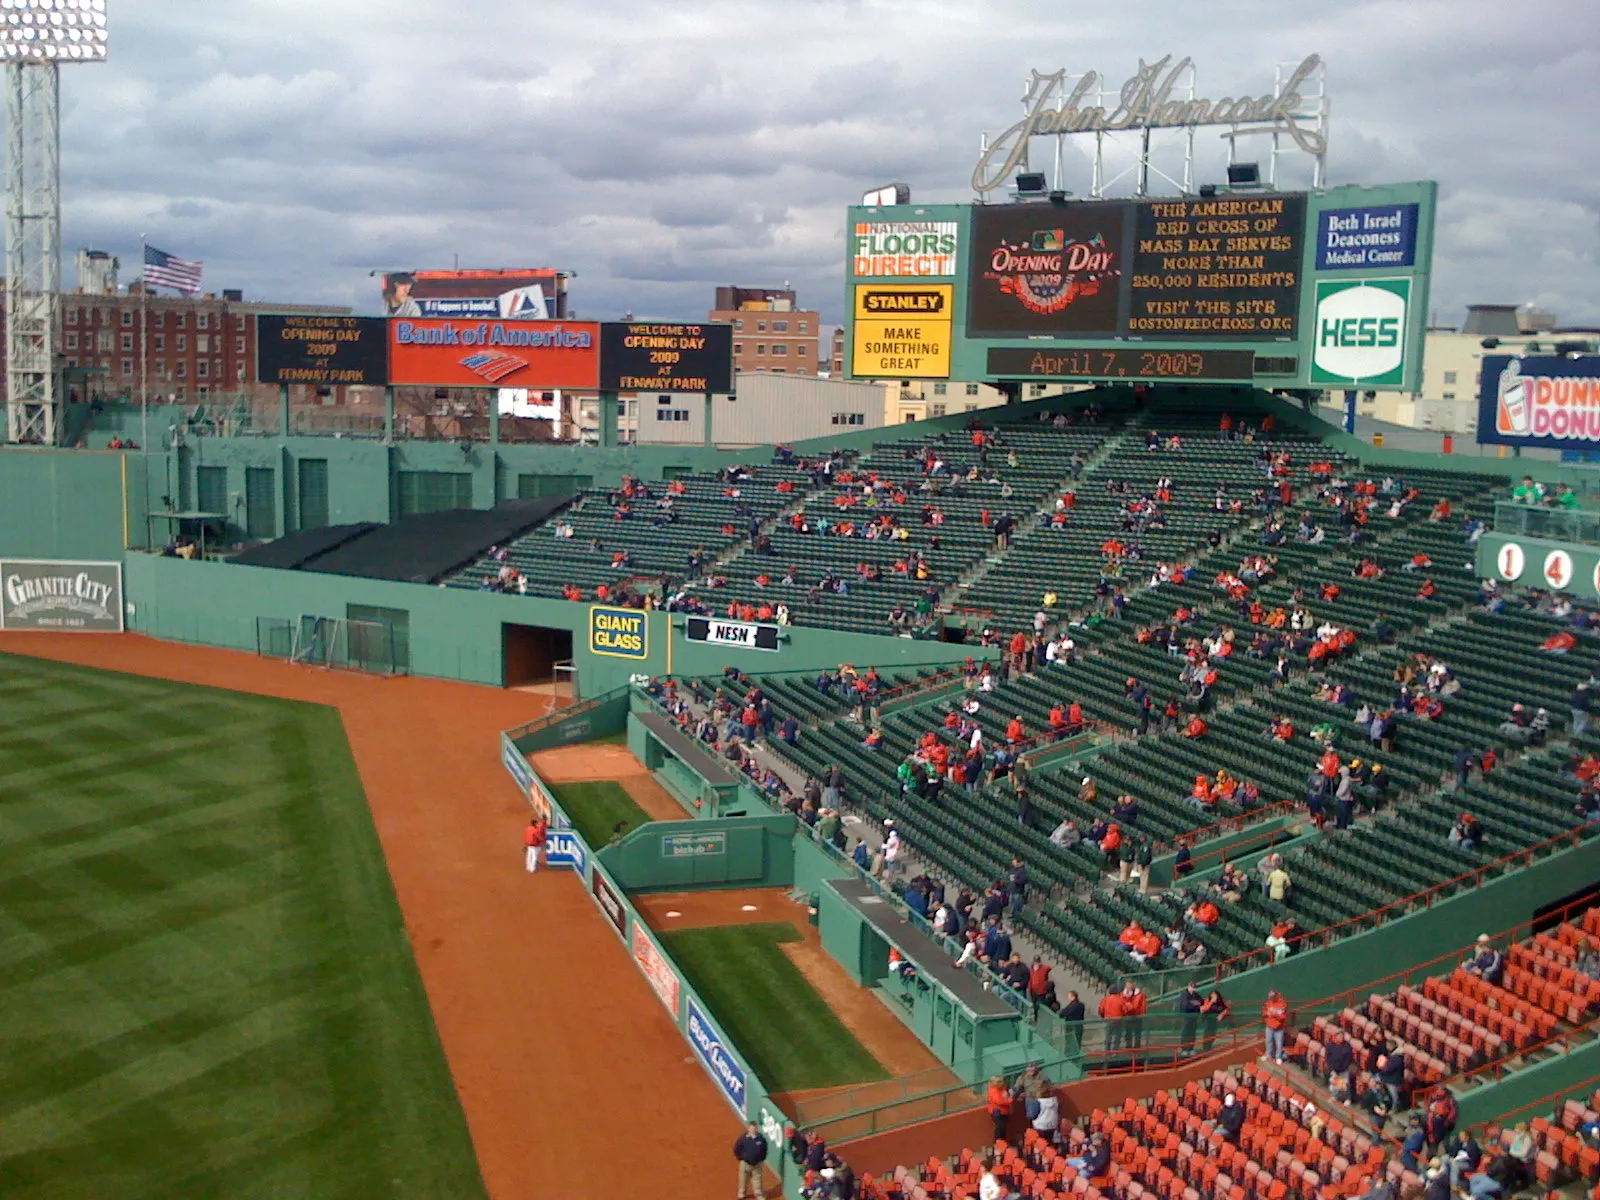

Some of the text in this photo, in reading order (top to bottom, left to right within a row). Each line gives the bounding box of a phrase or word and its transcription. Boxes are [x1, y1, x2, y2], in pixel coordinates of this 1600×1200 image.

[972, 54, 1327, 191] John Hancock
[1152, 200, 1283, 217] THE AMERICAN
[871, 223, 939, 234] NATIONAL
[1156, 219, 1278, 235] RED CROSS OF
[1328, 210, 1401, 231] Beth Israel
[855, 234, 955, 255] FLOORS
[1140, 236, 1292, 253] MASS BAY SERVES
[1327, 232, 1400, 248] Deaconess
[991, 244, 1113, 272] OPENING DAY
[1163, 255, 1265, 270] MORE THAN
[1326, 249, 1403, 264] Medical Center
[854, 256, 949, 276] DIRECT
[1030, 274, 1062, 287] 2009
[1132, 273, 1296, 289] 250,000 RESIDENTS
[868, 296, 939, 309] STANLEY
[1145, 300, 1276, 315] VISIT THE SITE
[286, 317, 357, 327] WELCOME TO
[628, 325, 701, 335] WELCOME TO
[282, 328, 362, 342] OPENING DAY
[397, 322, 591, 347] Bank of America
[884, 328, 921, 340] MAKE
[1321, 317, 1399, 347] HESS
[307, 343, 337, 355] 2009
[624, 336, 706, 349] OPENING DAY
[865, 342, 939, 355] SOMETHING
[650, 351, 680, 364] 2009
[1031, 352, 1092, 375] April
[1140, 352, 1203, 375] 2009
[279, 368, 364, 381] FENWAY PARK
[658, 366, 672, 375] AT
[620, 376, 707, 389] FENWAY PARK
[1504, 549, 1513, 577] 1
[1547, 556, 1564, 585] 4
[8, 572, 112, 607] GRANITE CITY
[596, 614, 641, 633] GIANT
[595, 632, 642, 650] GLASS
[716, 625, 748, 643] NESN
[689, 1015, 744, 1094] BUD LIGHT
